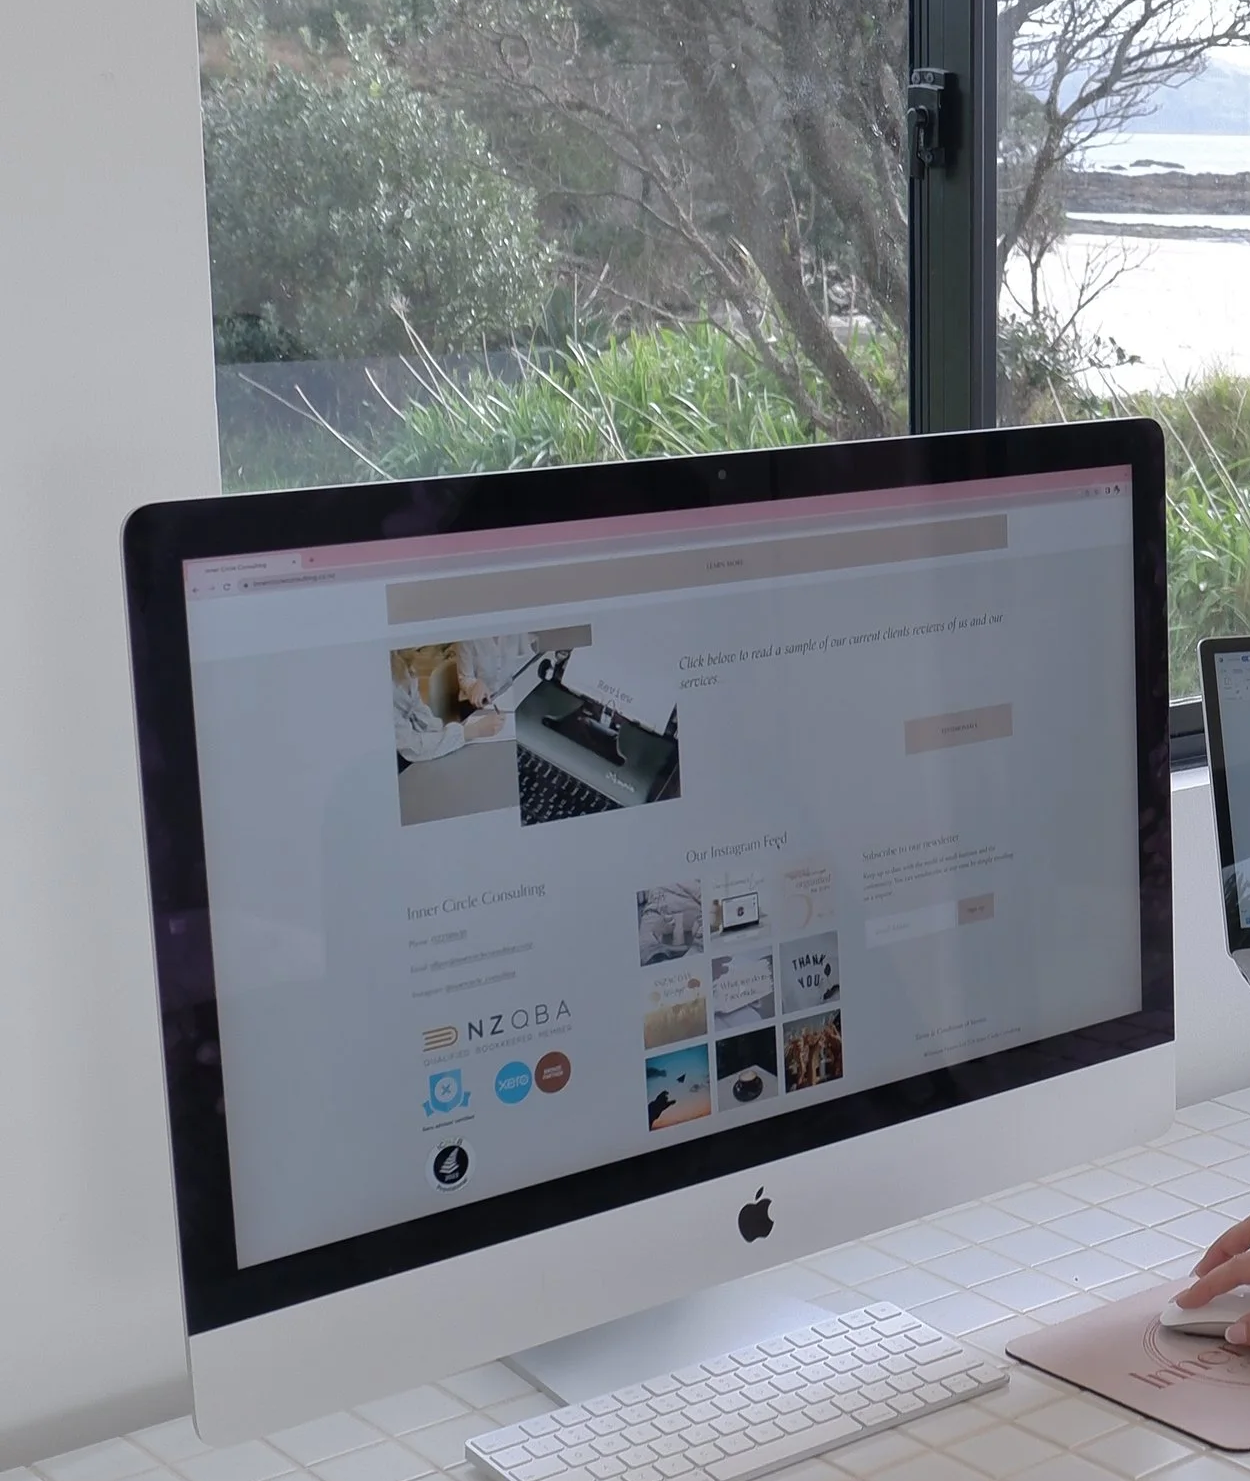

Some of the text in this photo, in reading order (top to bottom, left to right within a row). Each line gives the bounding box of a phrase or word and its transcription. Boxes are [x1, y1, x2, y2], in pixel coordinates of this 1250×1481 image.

[679, 613, 1003, 670] Click below to read a sample of our current clients reviews of us and our
[686, 830, 787, 863] Our Instagram Feed
[407, 883, 546, 921] Inner Circle Consulting
[792, 953, 827, 971] THANK
[797, 973, 821, 989] YOU
[468, 999, 572, 1042] NZQBA
[423, 1024, 573, 1068] QUALIFIED BOOKKEEPER MEMBER
[498, 1074, 529, 1091] xero
[1129, 1341, 1244, 1390] Inner
